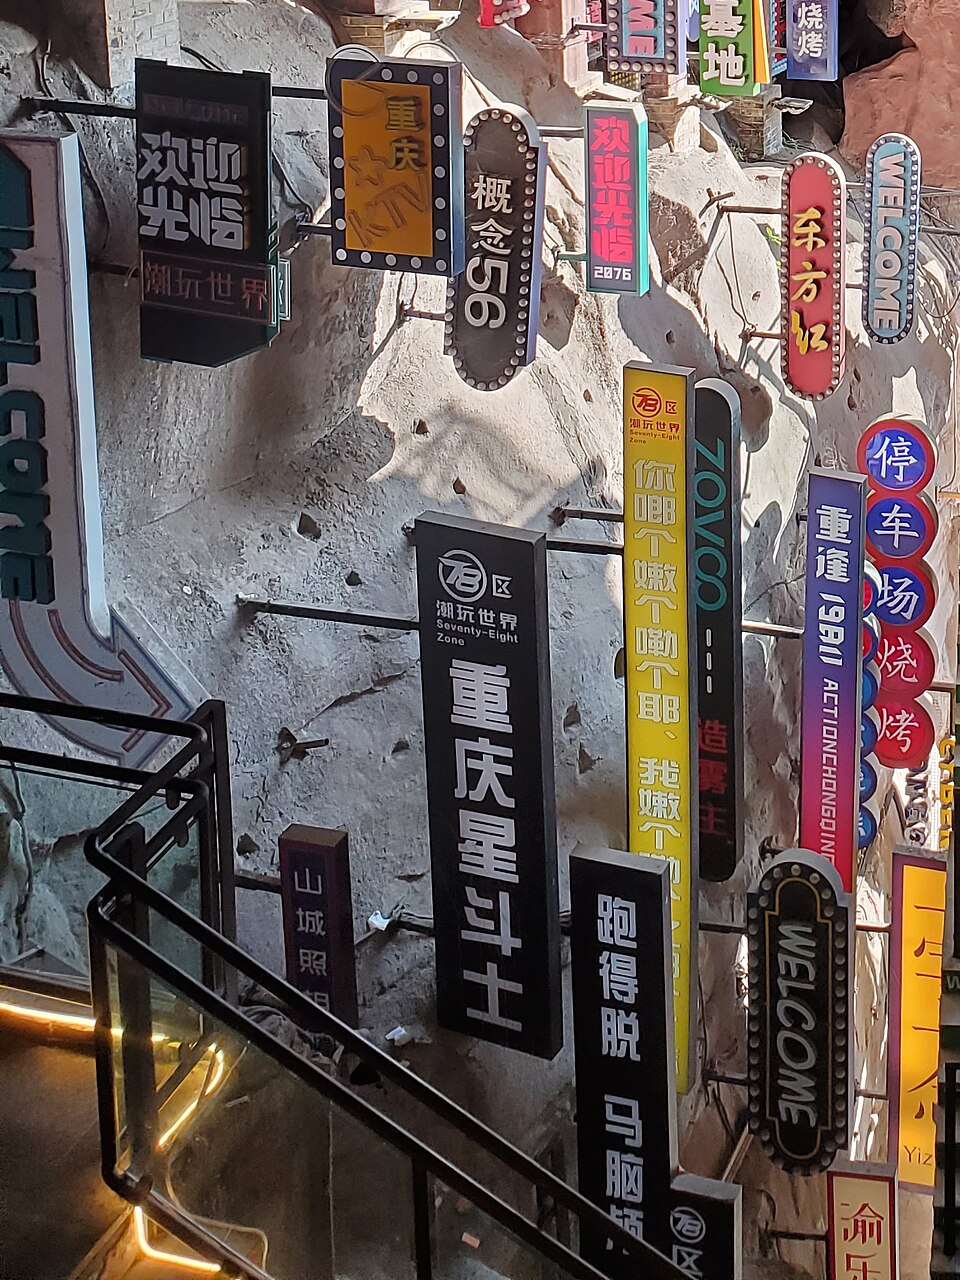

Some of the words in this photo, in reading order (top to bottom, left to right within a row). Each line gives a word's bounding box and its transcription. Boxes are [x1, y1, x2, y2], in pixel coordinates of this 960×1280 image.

[137, 131, 243, 195] 欢迎
[385, 95, 424, 171] 重庆
[138, 185, 244, 251] 光临
[346, 173, 428, 248] KTV
[591, 115, 633, 263] 欢迎光临
[464, 174, 513, 329] 概念56
[593, 265, 632, 282] 2076
[873, 153, 905, 331] WELCOME
[145, 261, 268, 311] 潮玩世界
[791, 206, 830, 356] 东方红
[630, 418, 680, 433] 潮玩世界
[630, 429, 680, 441] Seventy-Eight
[436, 599, 518, 631] 潮玩世界
[873, 435, 918, 754] 停车场烧烤
[437, 619, 519, 644] Seventy-Eight
[437, 632, 465, 646] Zone
[449, 658, 523, 1033] 重庆星斗士
[597, 892, 641, 1062] 跑得脱
[776, 922, 817, 1127] WELCOME
[903, 1144, 934, 1166] Yiz
